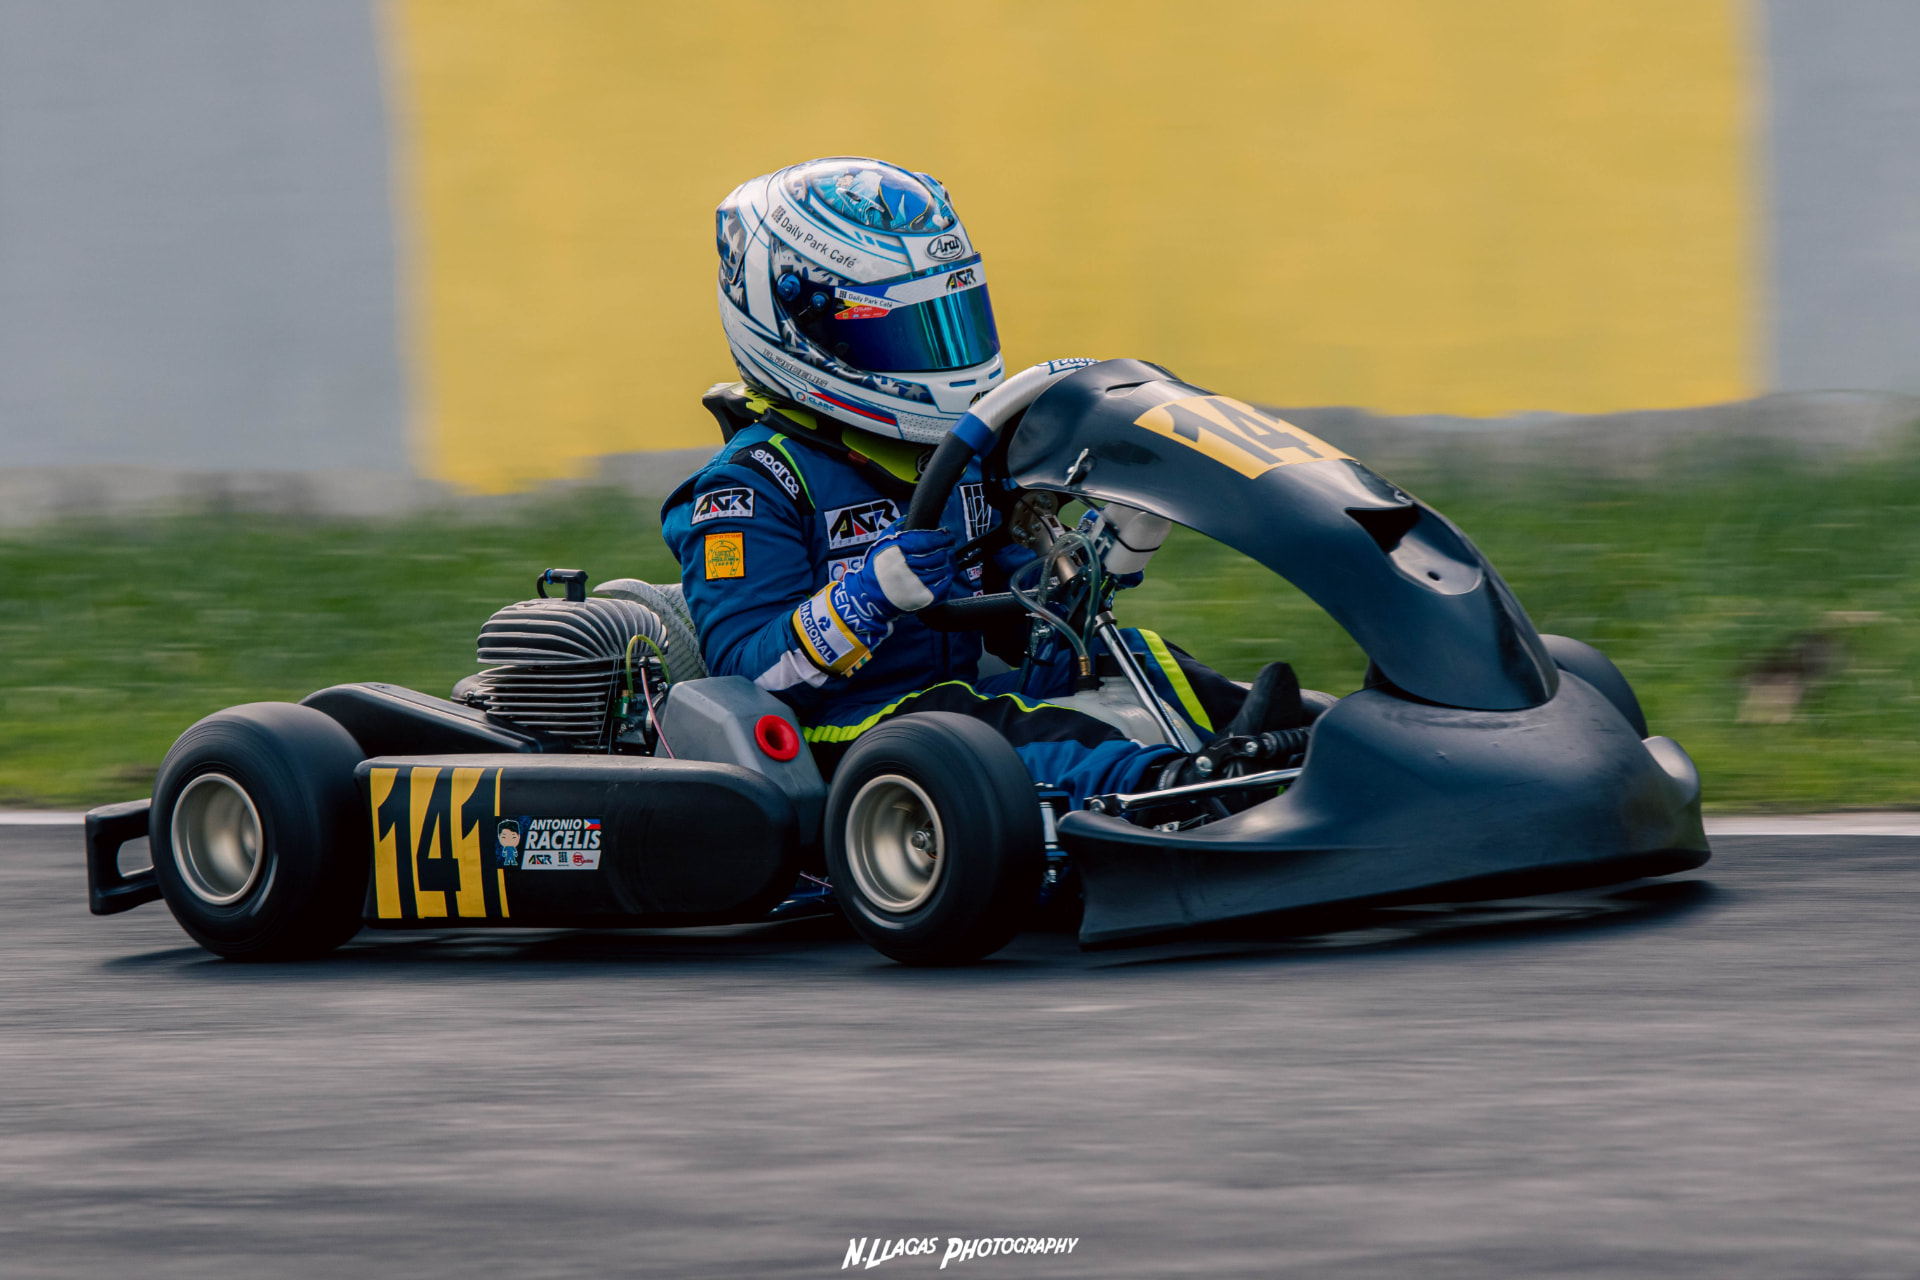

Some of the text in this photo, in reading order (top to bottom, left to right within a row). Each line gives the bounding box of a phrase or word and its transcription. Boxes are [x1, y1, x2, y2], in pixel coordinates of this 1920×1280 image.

[780, 216, 856, 269] Daily Park Café
[930, 237, 960, 255] Arai
[848, 293, 864, 304] Daily
[864, 296, 878, 306] Park
[750, 449, 800, 500] sparco
[800, 602, 832, 662] NACIONAL
[525, 830, 601, 849] RACELIS
[529, 819, 582, 830] ANTONIO
[377, 767, 503, 918] 141
